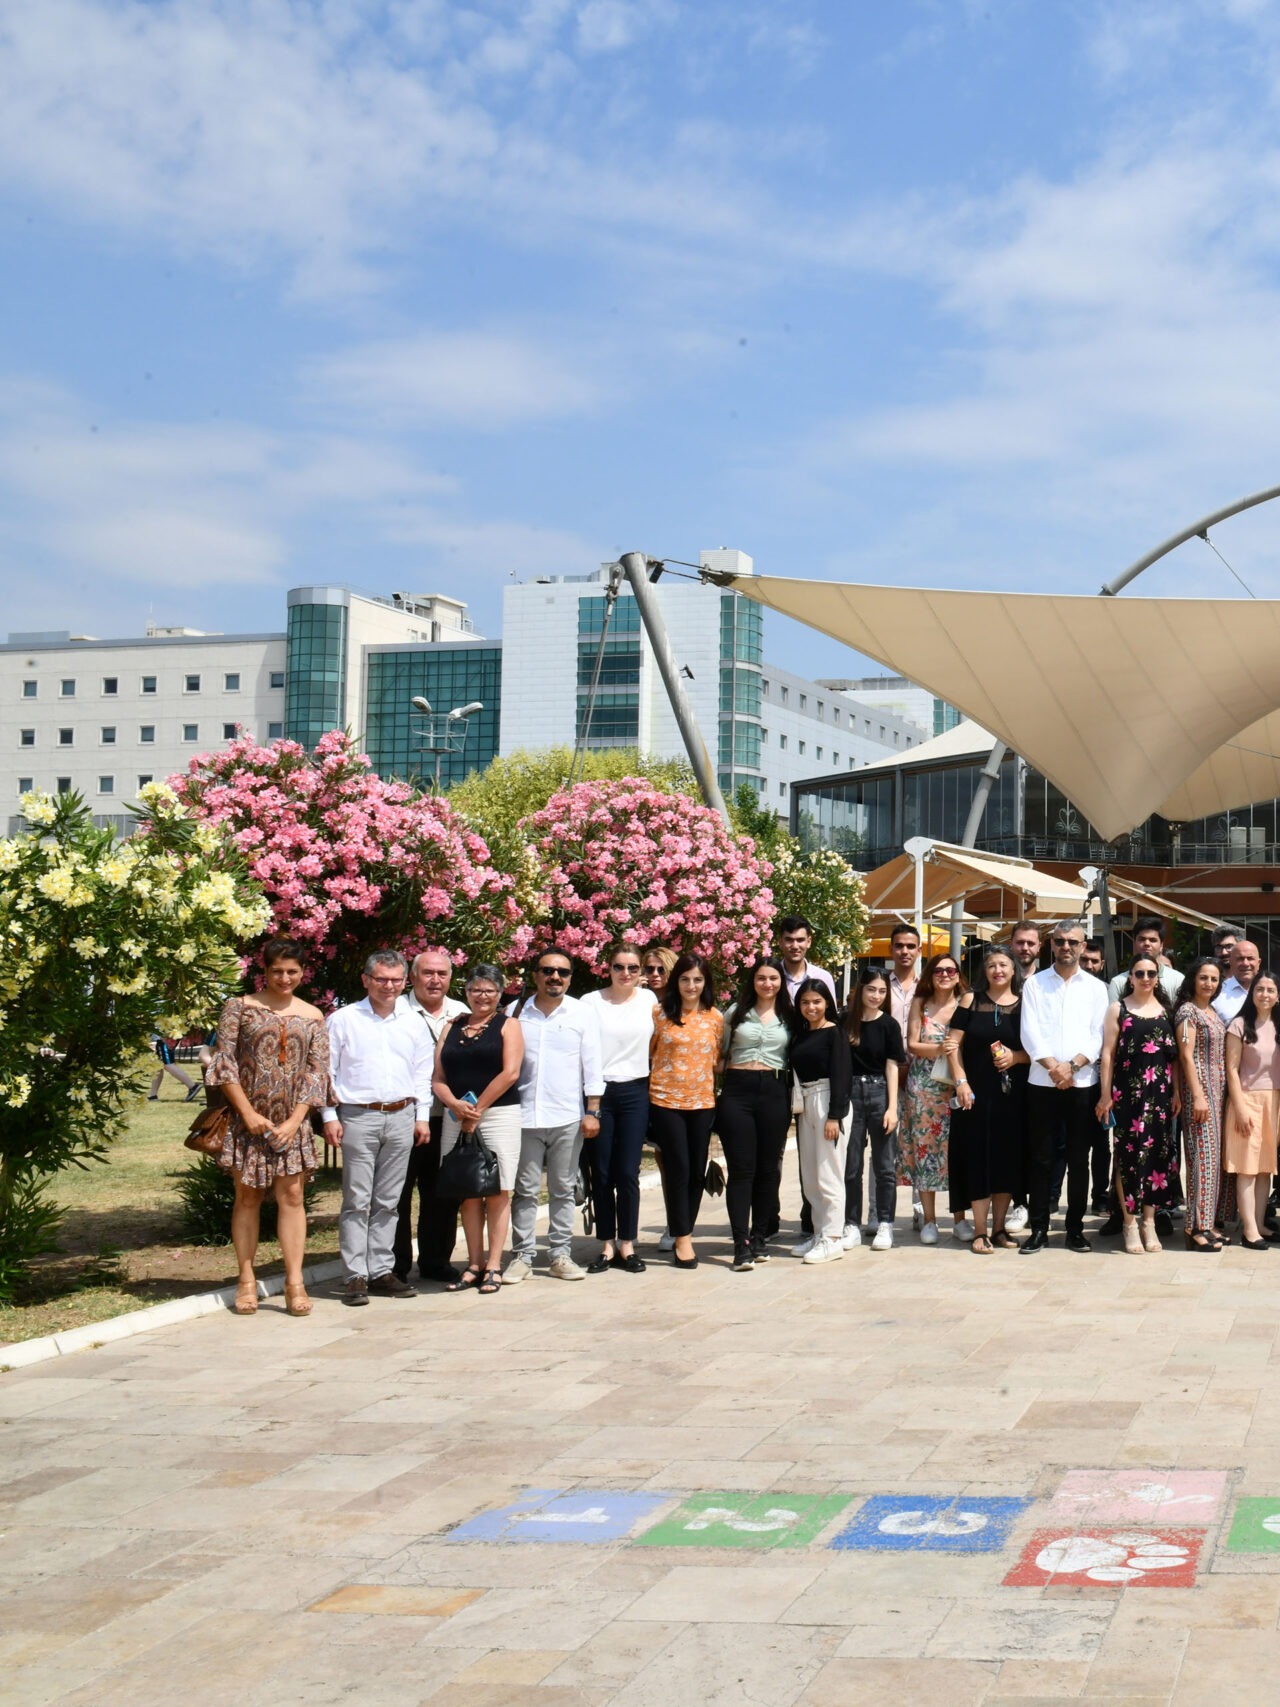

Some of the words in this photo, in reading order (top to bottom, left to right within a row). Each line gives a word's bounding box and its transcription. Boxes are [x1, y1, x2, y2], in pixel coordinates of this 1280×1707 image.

[508, 1507, 611, 1523] 1
[683, 1507, 799, 1531] 2
[878, 1510, 988, 1534] 3
